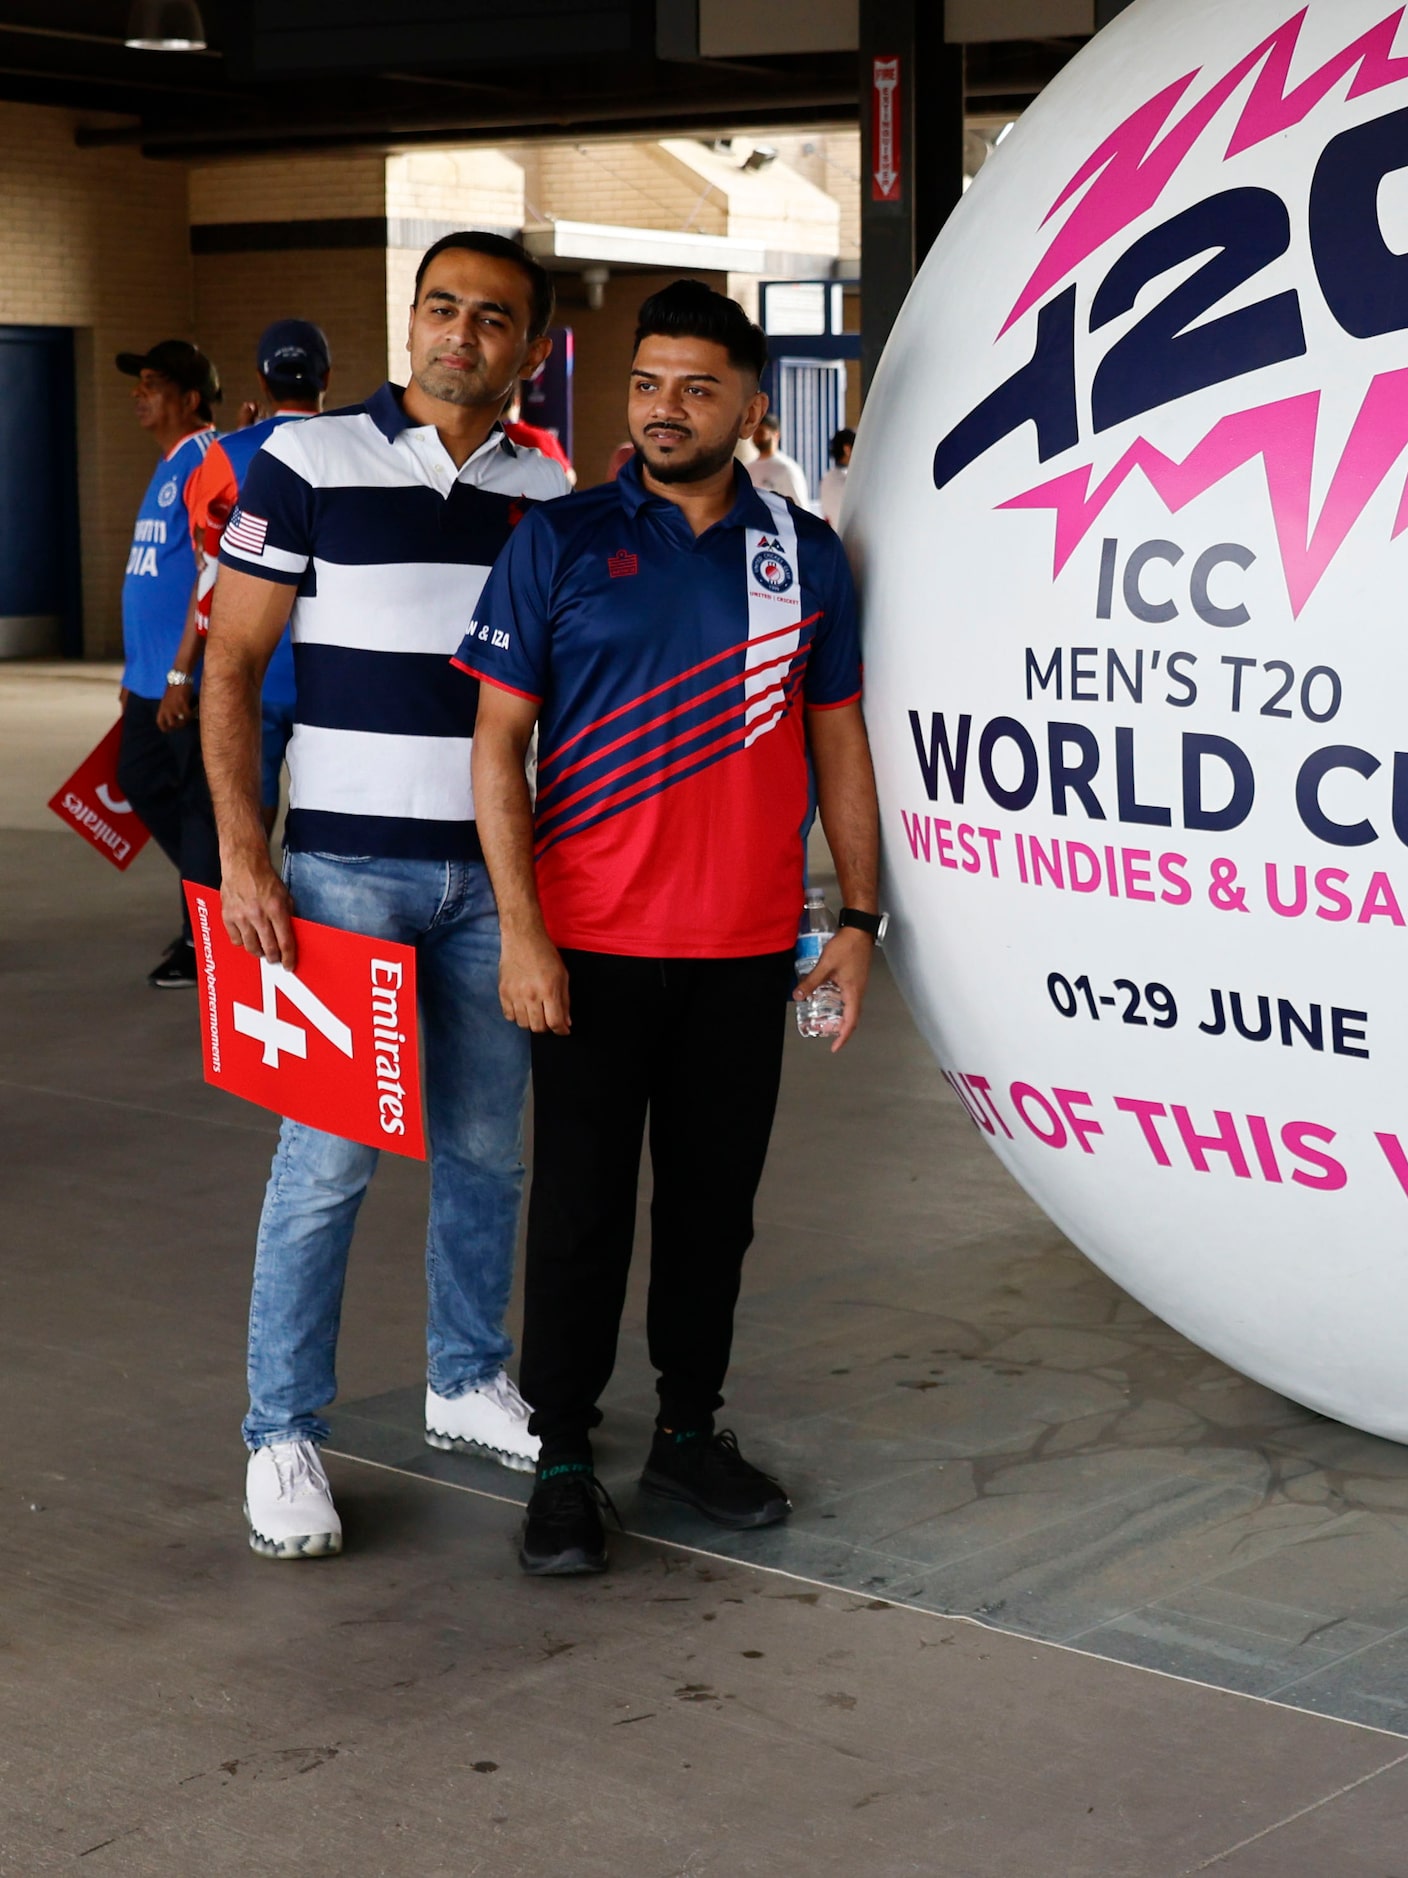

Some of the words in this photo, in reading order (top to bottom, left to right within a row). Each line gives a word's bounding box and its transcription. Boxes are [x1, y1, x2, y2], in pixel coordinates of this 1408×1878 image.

[478, 625, 490, 642] &
[491, 629, 510, 650] IZA
[1096, 537, 1257, 628] ICC
[1025, 647, 1198, 708] MEN'S
[1221, 655, 1342, 723] T20
[908, 710, 1255, 832] WORLD
[61, 792, 131, 861] Emirates
[901, 809, 1001, 877] WEST
[1014, 833, 1193, 905] INDIES
[1208, 858, 1250, 913] &
[1265, 862, 1406, 927] USA
[196, 897, 221, 1073] #Emiratesflybettermoments
[233, 955, 354, 1069] 4
[1046, 971, 1178, 1029] 01-29
[1198, 988, 1370, 1060] JUNE
[371, 958, 405, 1136] Emirates
[1009, 1081, 1104, 1154] OF
[1113, 1096, 1348, 1191] THIS
